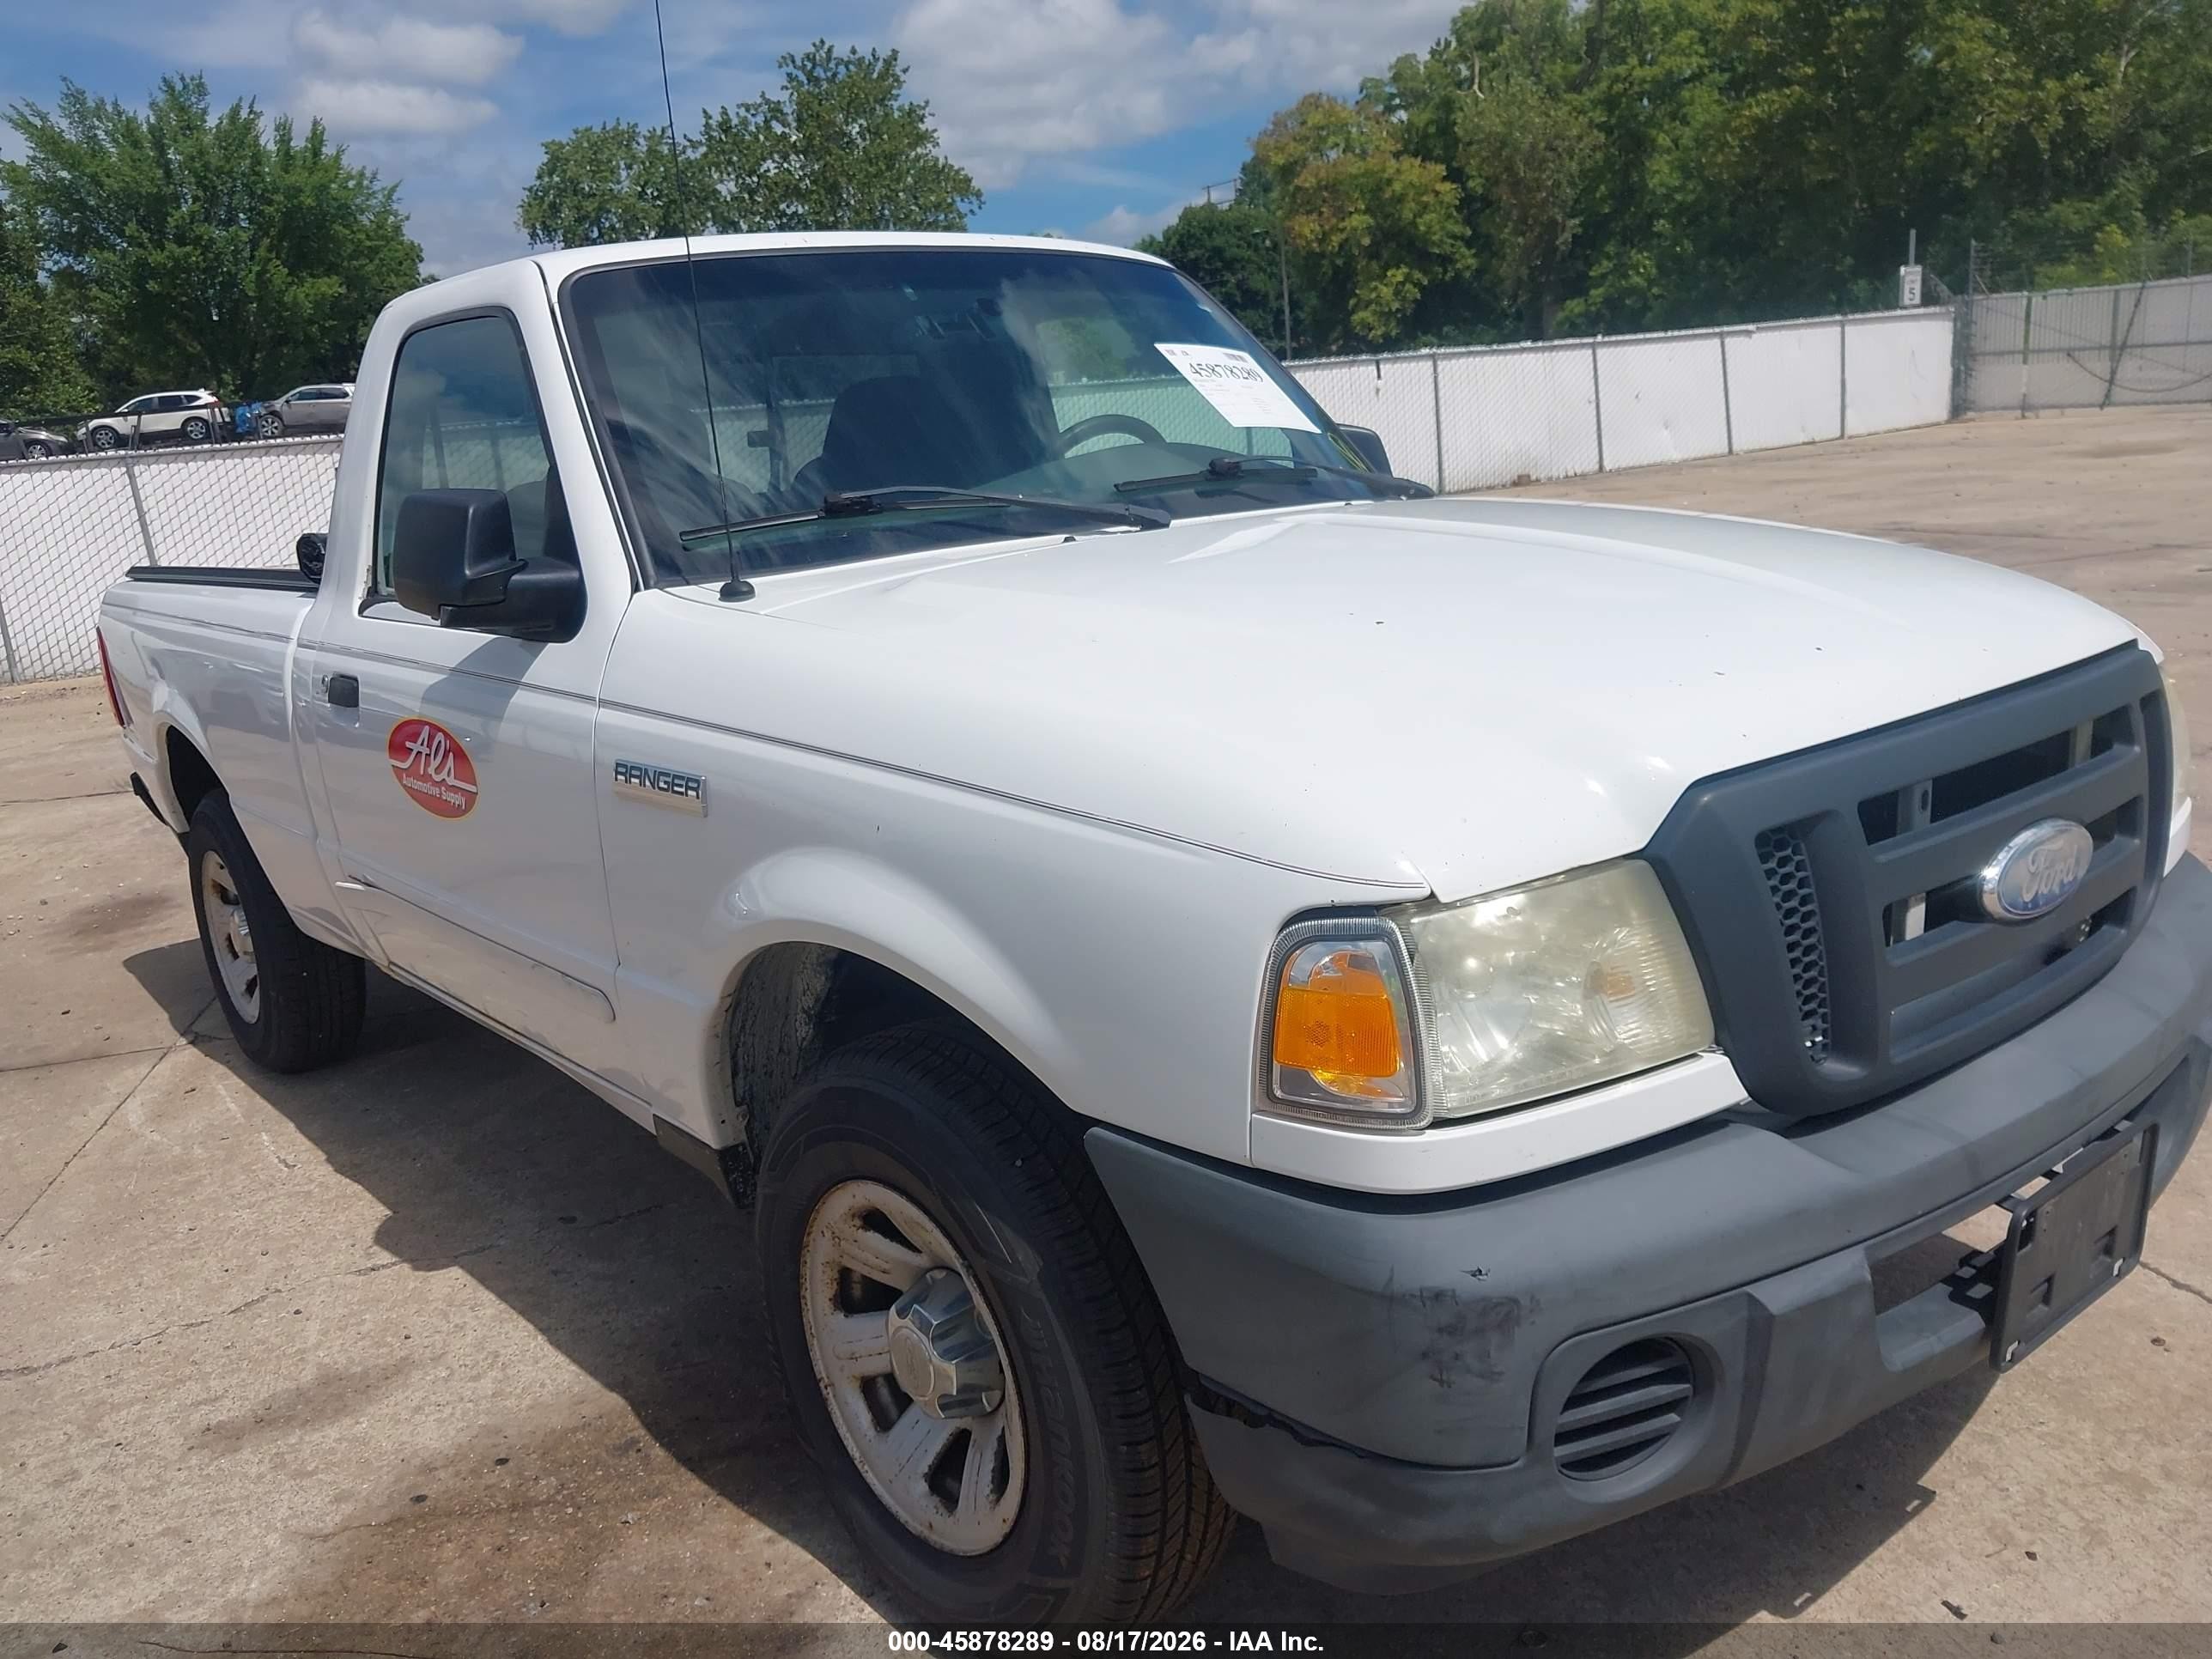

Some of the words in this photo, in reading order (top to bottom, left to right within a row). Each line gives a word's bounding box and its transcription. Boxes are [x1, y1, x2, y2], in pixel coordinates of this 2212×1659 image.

[1909, 288, 1916, 301] 5
[1188, 362, 1264, 383] 45878289
[397, 726, 466, 787] Al's
[403, 774, 441, 798] Automotive
[441, 787, 465, 811] Supply
[614, 762, 702, 799] RANGER
[2021, 841, 2078, 902] Ford
